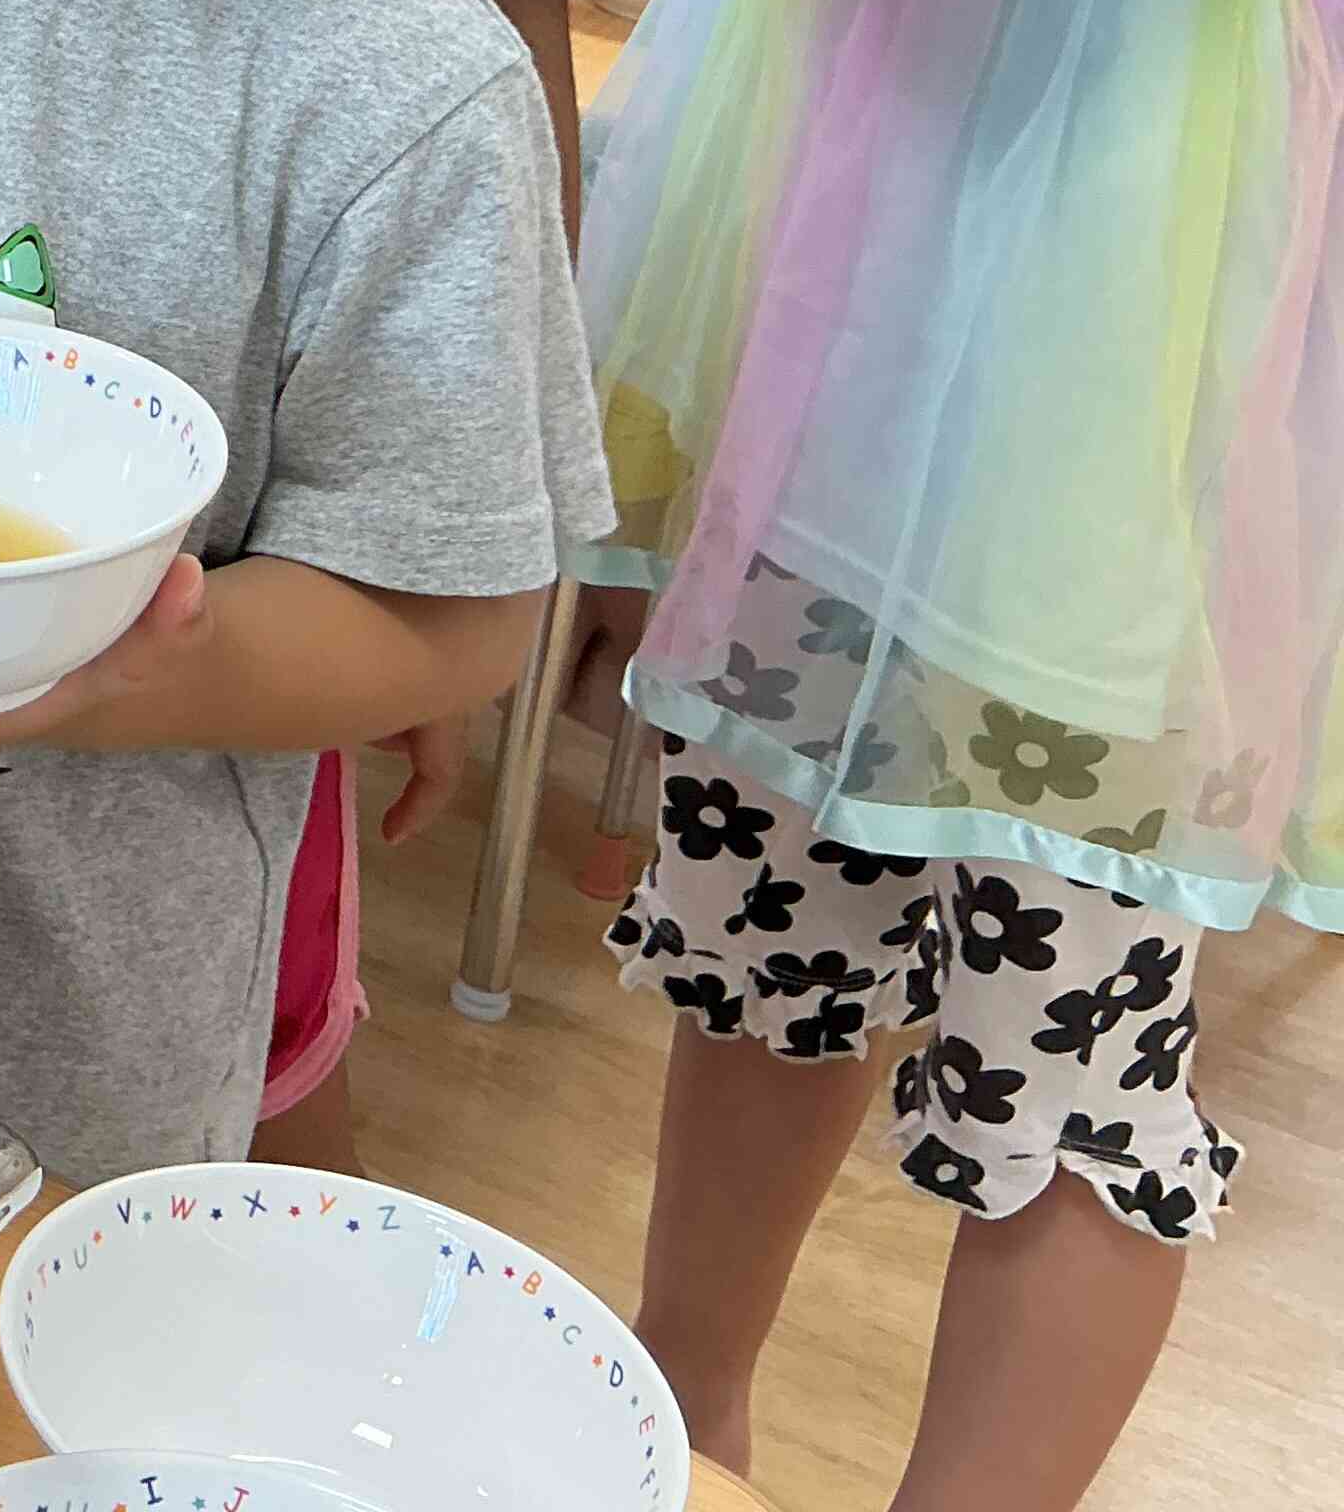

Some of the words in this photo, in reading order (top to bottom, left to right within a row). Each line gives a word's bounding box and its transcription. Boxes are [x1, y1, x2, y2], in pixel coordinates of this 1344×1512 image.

[14, 348, 29, 371] A
[64, 347, 79, 370] B
[104, 380, 120, 400] C
[150, 396, 162, 419] D
[73, 1244, 88, 1270] U
[117, 1197, 131, 1224] V
[171, 1195, 197, 1221] W
[243, 1190, 267, 1218] X
[377, 1205, 401, 1231] Z
[466, 1250, 485, 1276] A
[522, 1271, 543, 1296] B
[562, 1324, 583, 1345] C
[609, 1360, 624, 1388] D
[140, 1476, 163, 1505] I
[224, 1486, 250, 1512] J
